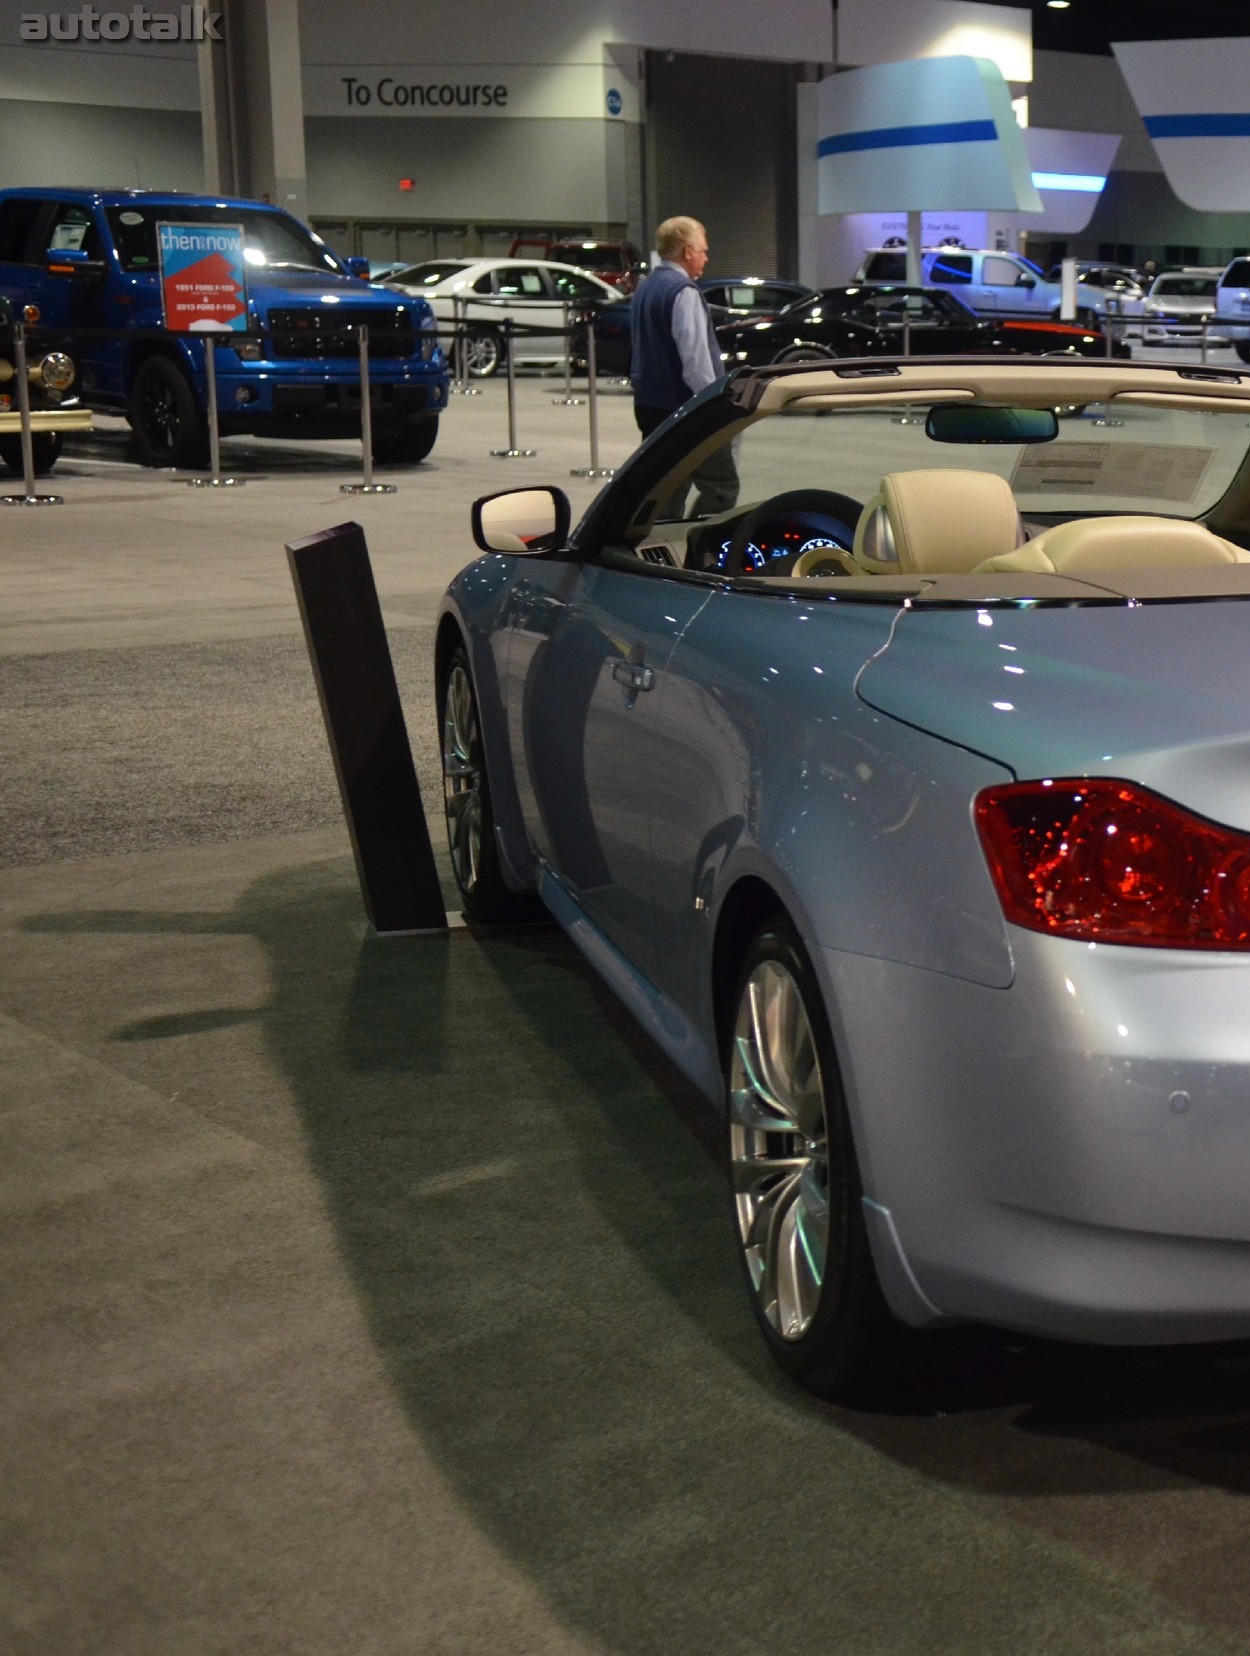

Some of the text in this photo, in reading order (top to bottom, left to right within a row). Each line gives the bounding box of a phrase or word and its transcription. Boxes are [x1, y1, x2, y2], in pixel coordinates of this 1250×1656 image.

[342, 77, 508, 107] To Concourse
[161, 226, 200, 250] then
[206, 236, 240, 251] now
